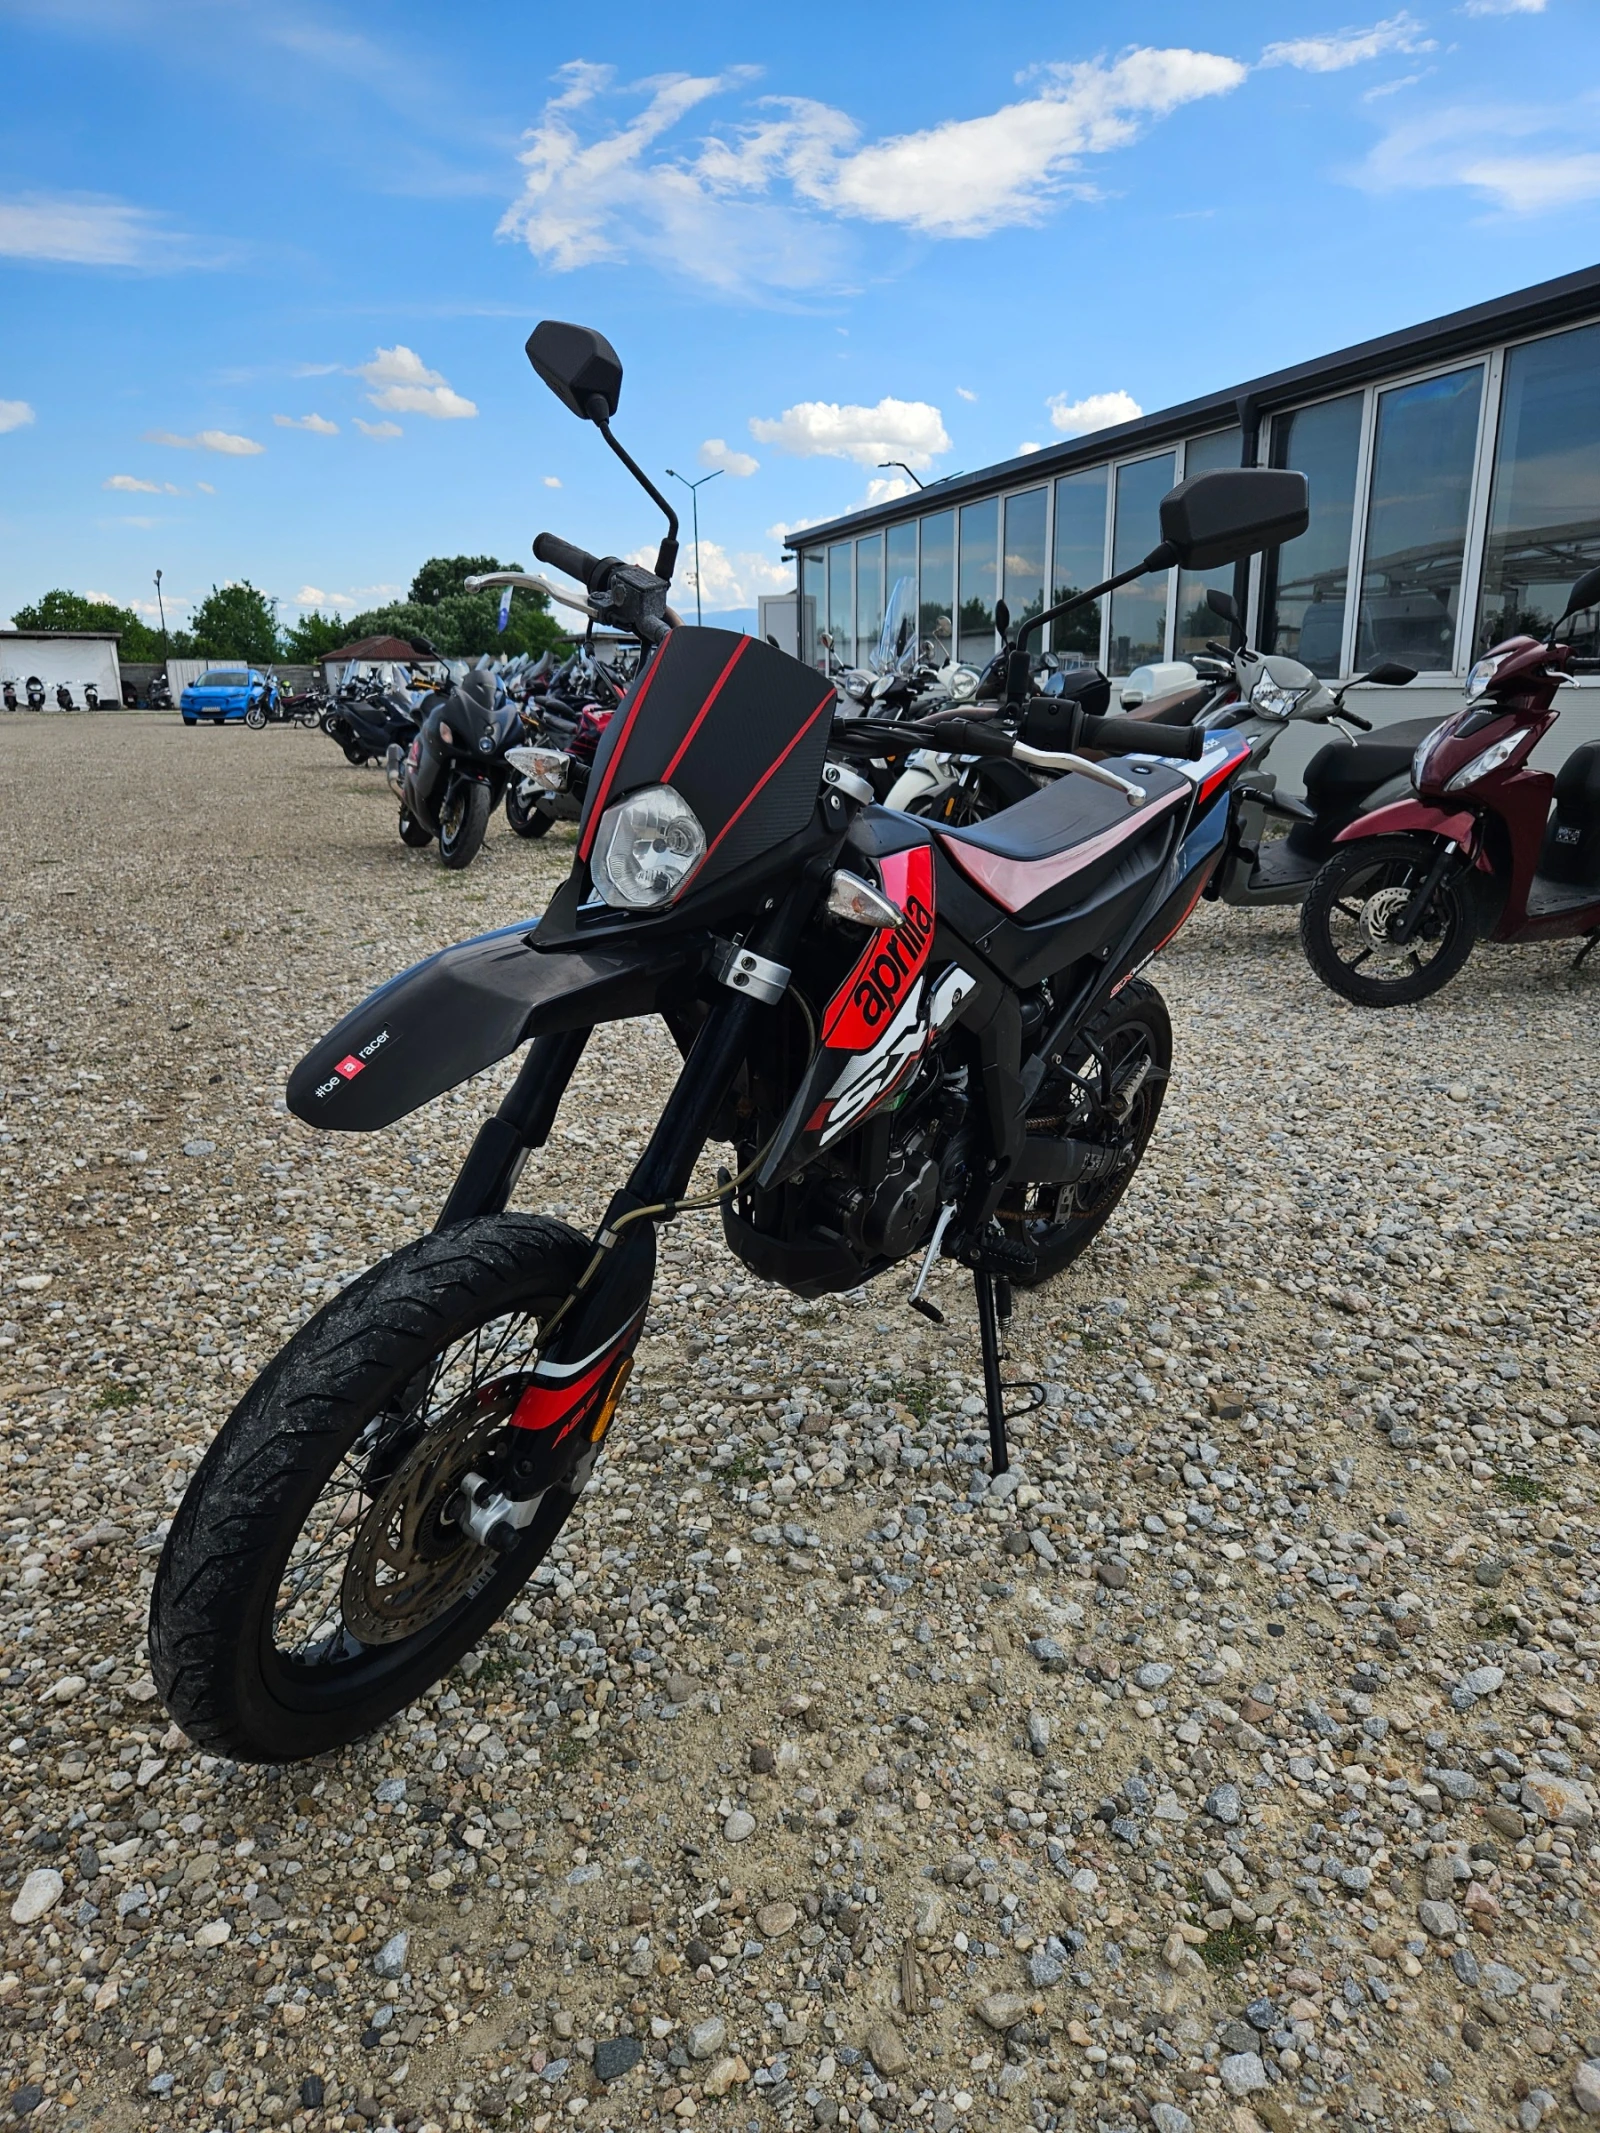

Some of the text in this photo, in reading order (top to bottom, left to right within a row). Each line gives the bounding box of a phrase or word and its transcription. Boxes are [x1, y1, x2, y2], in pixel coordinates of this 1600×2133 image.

[854, 896, 932, 1026] aprilia
[315, 1077, 340, 1098] #be
[359, 1030, 389, 1059] racer
[819, 1019, 926, 1147] SX
